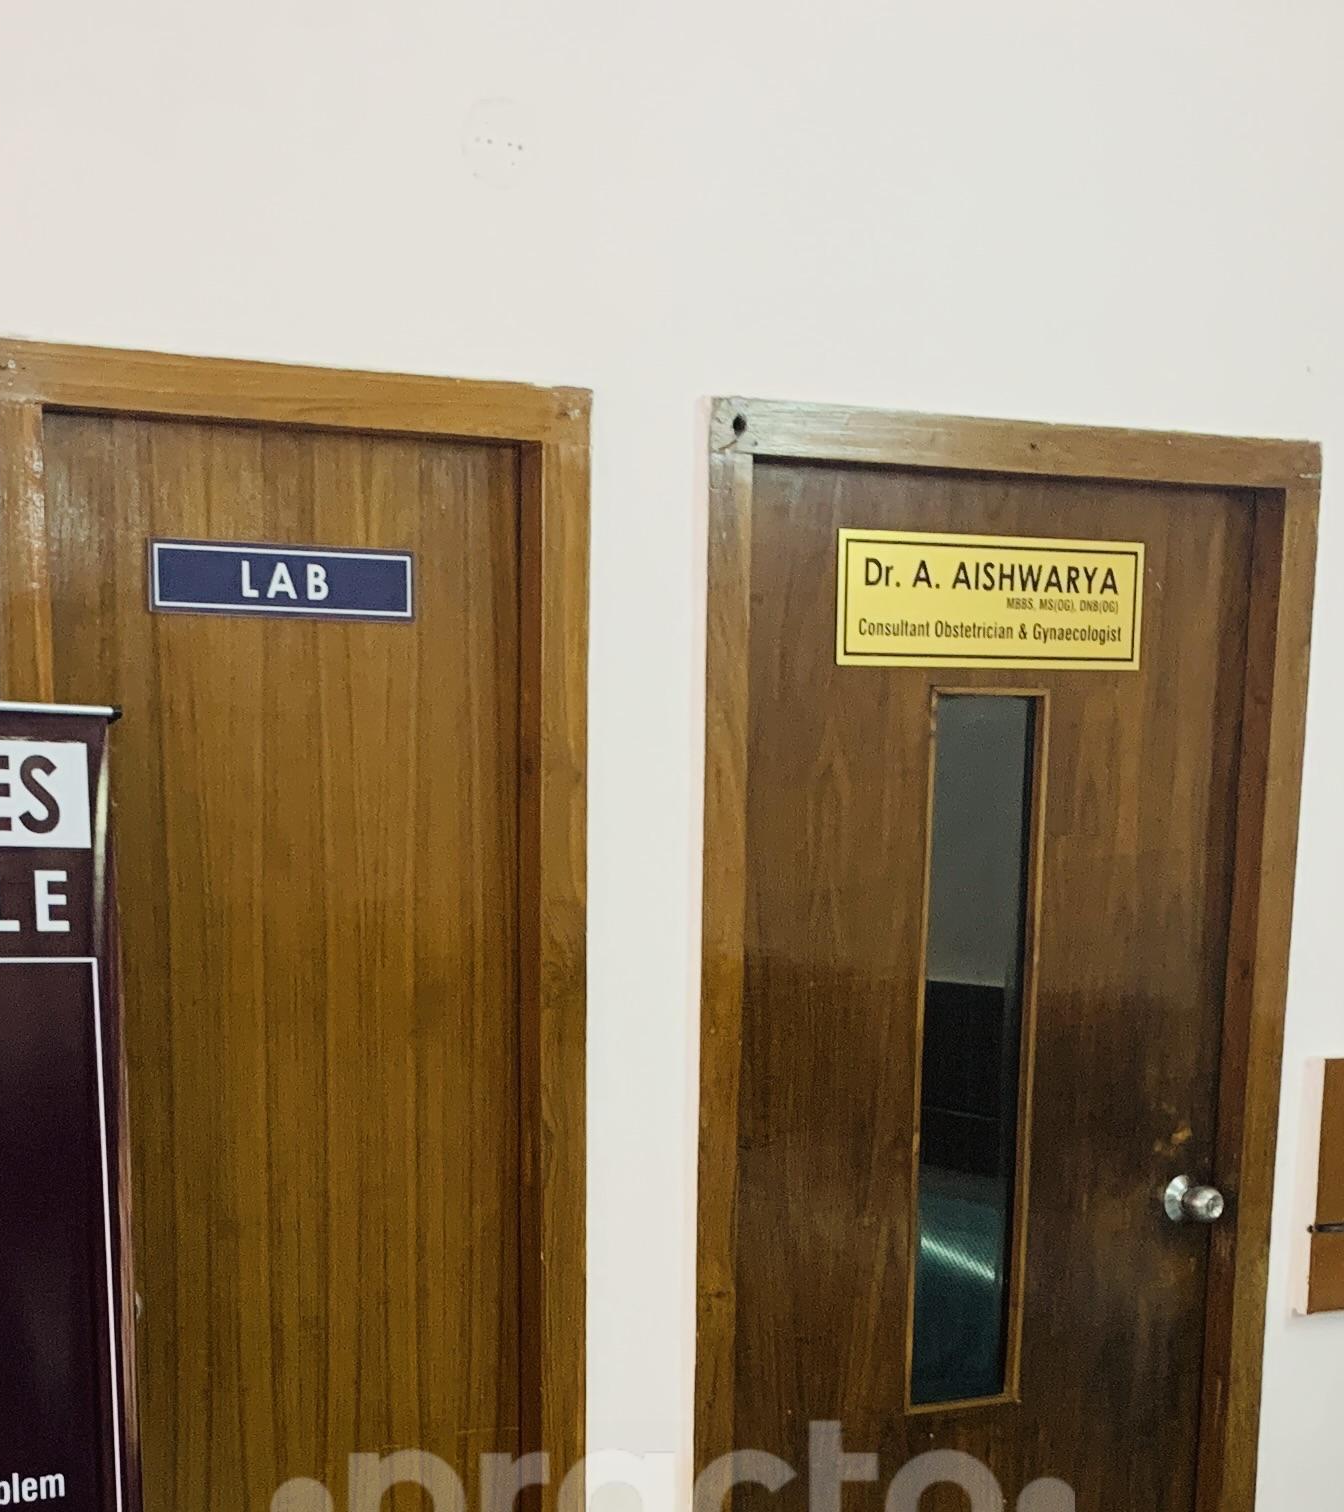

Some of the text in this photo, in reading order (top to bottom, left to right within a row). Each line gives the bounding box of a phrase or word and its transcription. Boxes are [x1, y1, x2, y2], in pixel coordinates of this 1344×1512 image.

[241, 559, 329, 601] LAB
[864, 557, 1119, 595] Dr. A. AISHWARYA
[858, 617, 1121, 645] Consultant Obstetrician & Gynaecologist
